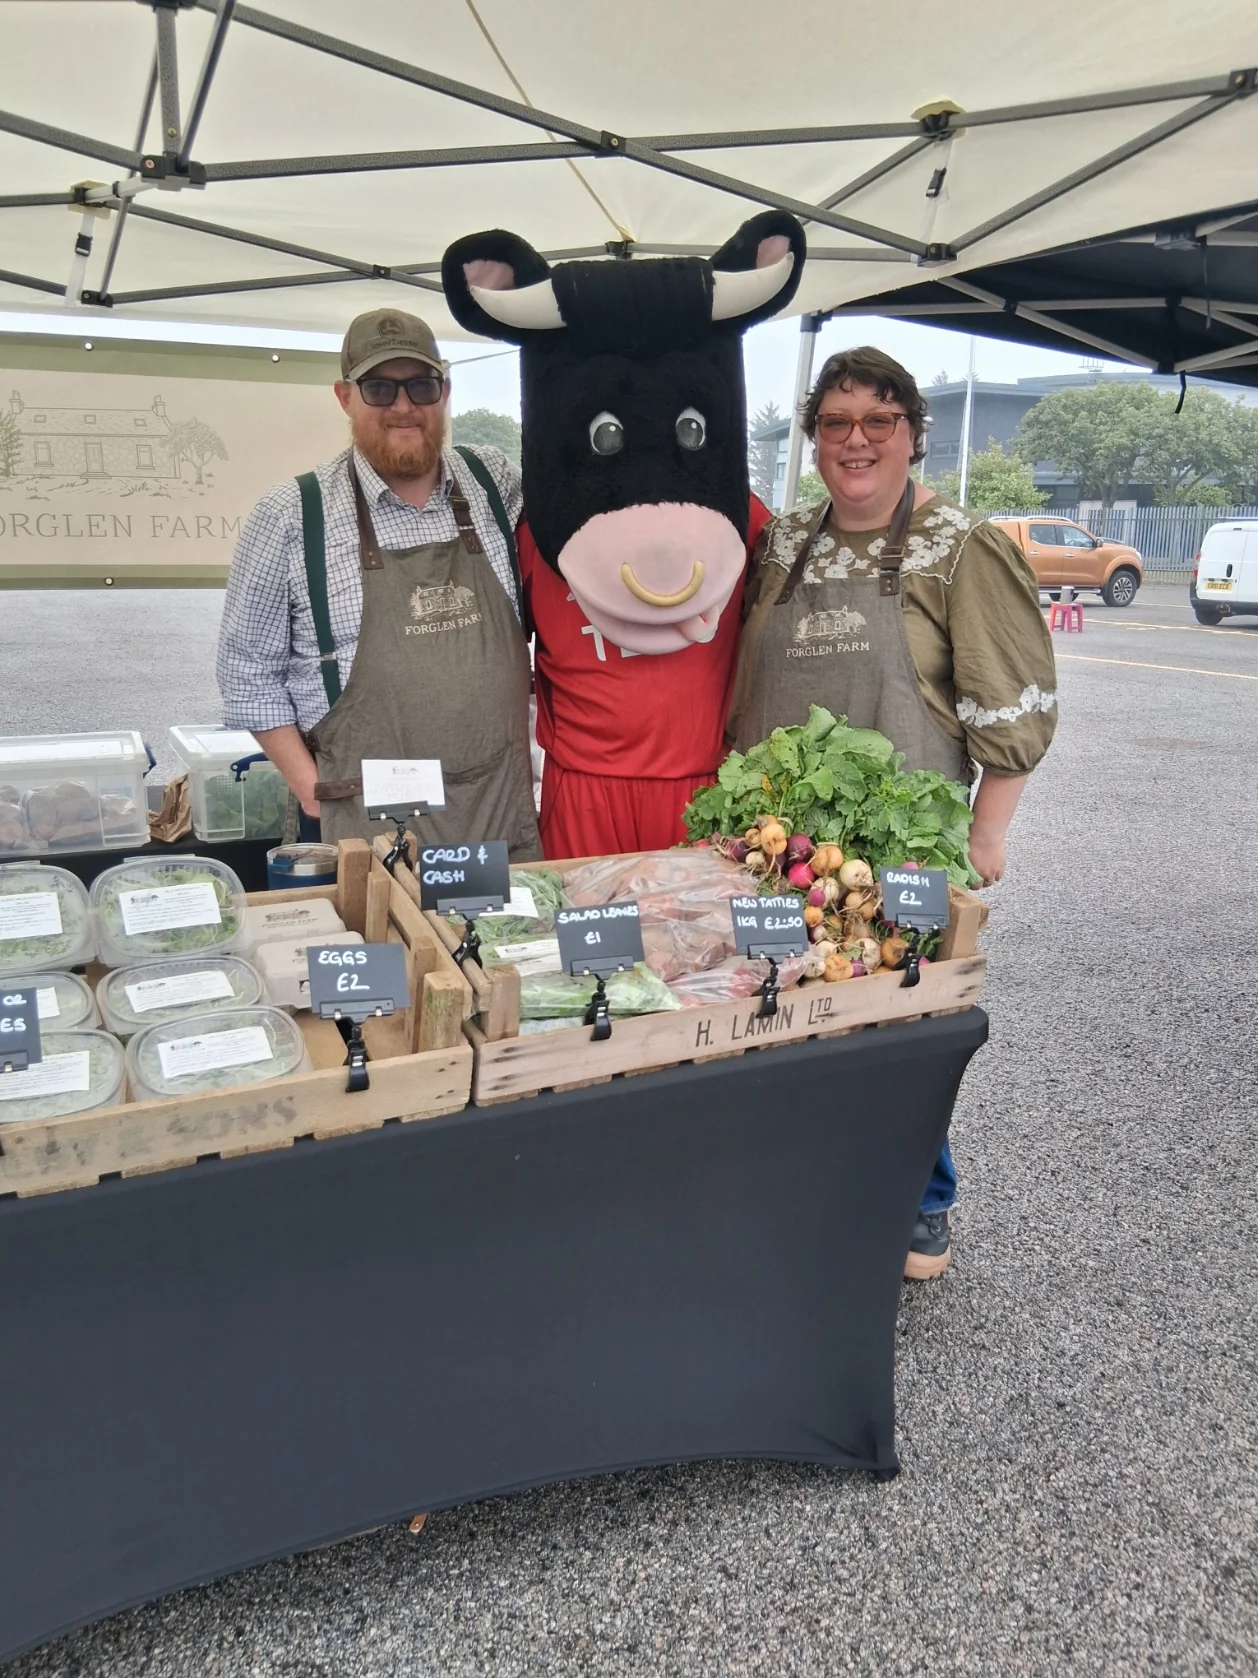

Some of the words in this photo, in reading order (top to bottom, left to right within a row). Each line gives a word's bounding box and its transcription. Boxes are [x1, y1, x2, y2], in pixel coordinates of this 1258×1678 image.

[0, 513, 133, 538] RGLEN
[150, 515, 242, 539] FARM
[405, 620, 456, 635] FORGLEN
[786, 645, 833, 658] FORGLEN
[836, 641, 870, 653] FARM
[422, 846, 471, 864] CARD
[477, 844, 489, 865] &
[422, 869, 466, 885] CASH
[886, 871, 931, 888] RADISH
[732, 896, 758, 909] NEW
[758, 896, 800, 909] TATTIES
[557, 909, 601, 924] SALAD
[602, 905, 639, 918] LEAVES
[737, 915, 758, 928] 1KG
[318, 950, 368, 966] EGGS
[695, 1020, 714, 1047] H.
[731, 1003, 795, 1040] LAMIN
